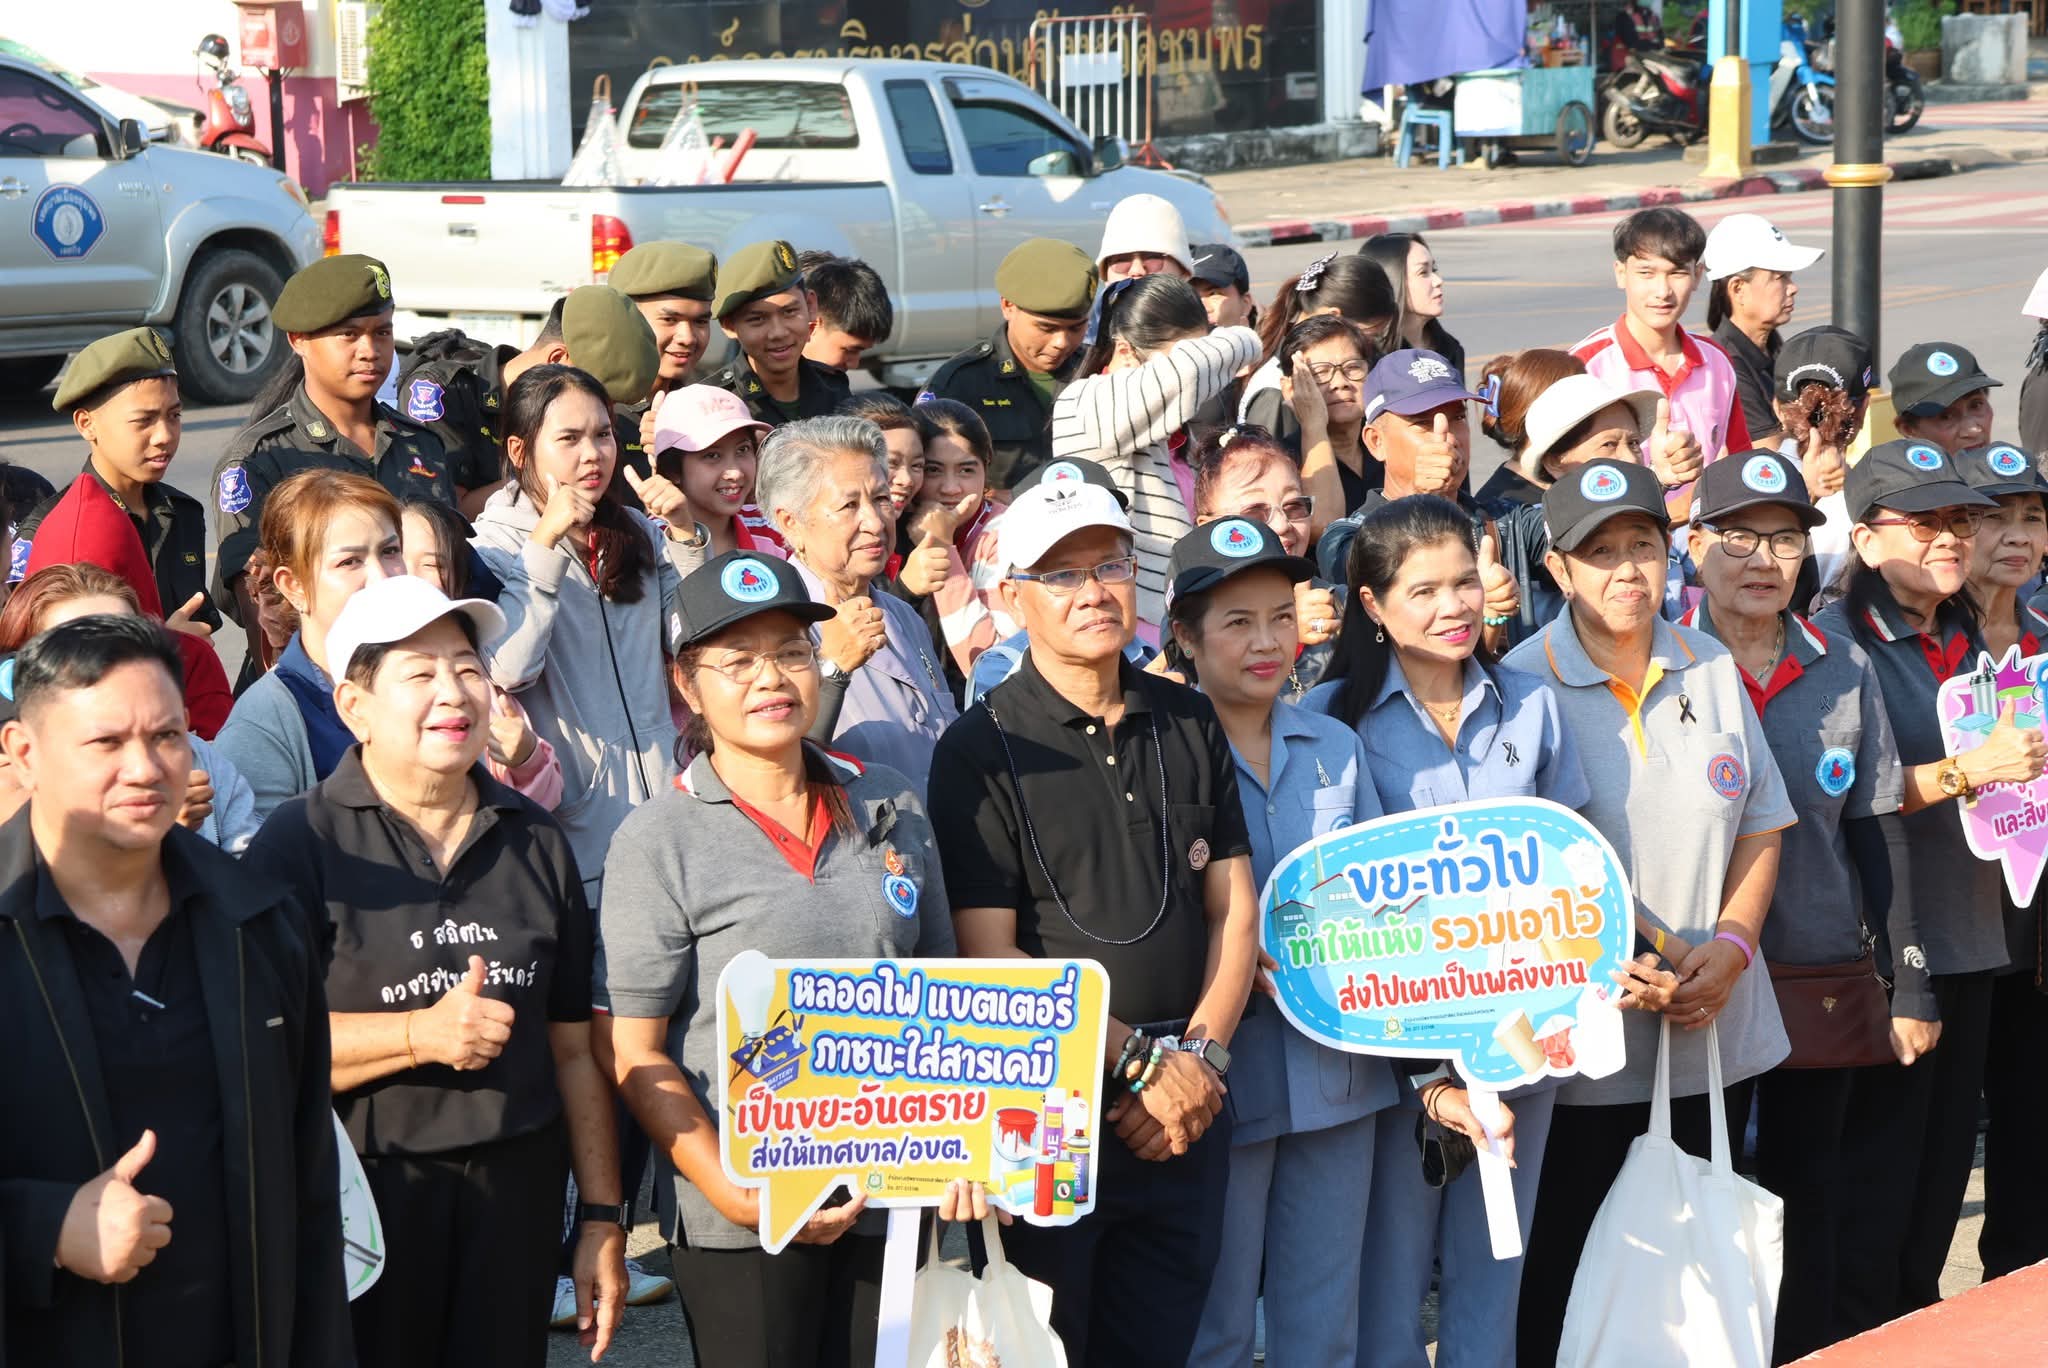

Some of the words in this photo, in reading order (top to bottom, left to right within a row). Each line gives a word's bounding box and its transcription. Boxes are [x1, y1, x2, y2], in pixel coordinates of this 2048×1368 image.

[1994, 789, 2048, 837] และสิ่ง
[1348, 820, 1539, 903] ขยะทั่วไป
[1288, 913, 1423, 966] ทำให้แห้ง
[1431, 886, 1604, 951] รวมเอาไว้
[790, 965, 924, 1020] หลอดไฟ
[926, 968, 1080, 1030] แบตเตอรี่
[1338, 957, 1588, 1012] ส่งไปเผาเป็นพลังงาน
[812, 1029, 1058, 1088] ภาชนะใส่สารเคมี
[737, 1084, 986, 1133] เป็นขยะอันตราย
[752, 1136, 969, 1168] ส่งให้เทศบาล/อบต.
